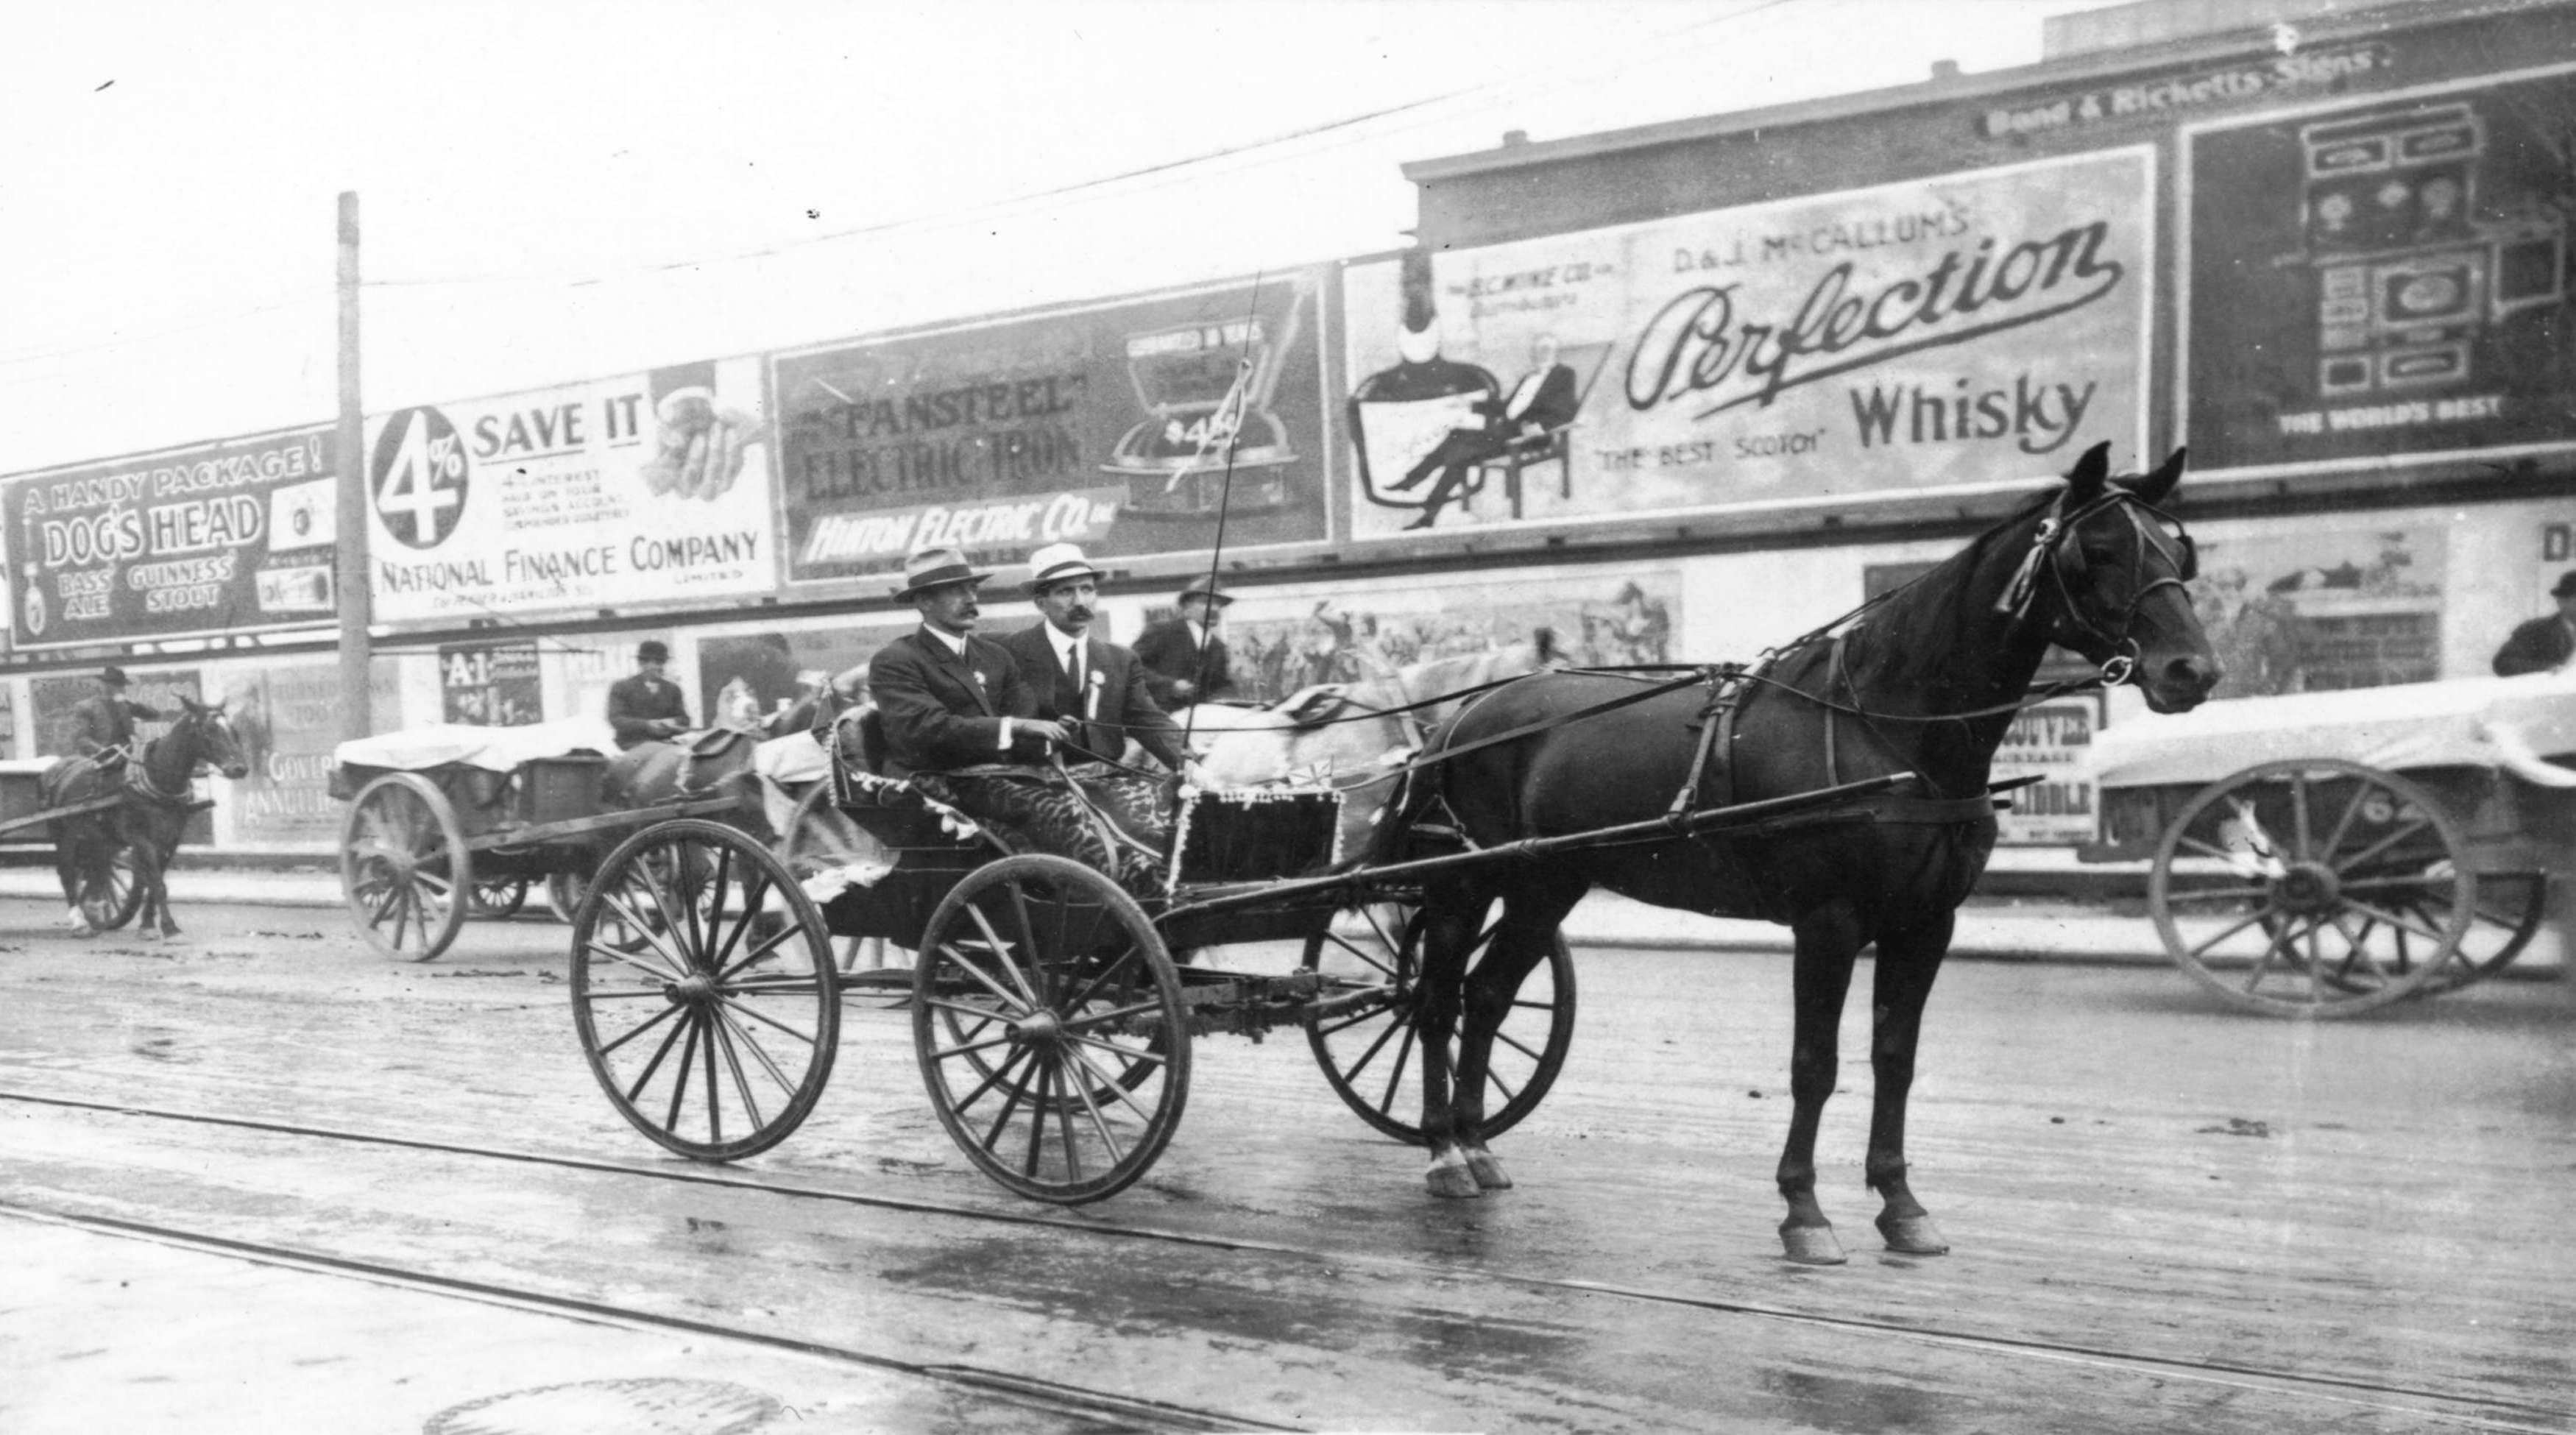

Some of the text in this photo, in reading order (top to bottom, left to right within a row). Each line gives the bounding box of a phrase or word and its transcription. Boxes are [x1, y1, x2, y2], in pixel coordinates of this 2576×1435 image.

[1625, 220, 2123, 414] Perfection
[473, 392, 643, 458] SAVE IT
[1850, 374, 2097, 455] Whisky
[24, 434, 322, 515] A HANDY PACKAGE!
[804, 425, 1082, 500] ELECTRIC IRON
[1660, 442, 1714, 467] BEST
[148, 494, 265, 556] HEAD
[381, 560, 493, 595] NATIONAL
[505, 545, 617, 584] FINANCE
[630, 531, 759, 572] COMPANY
